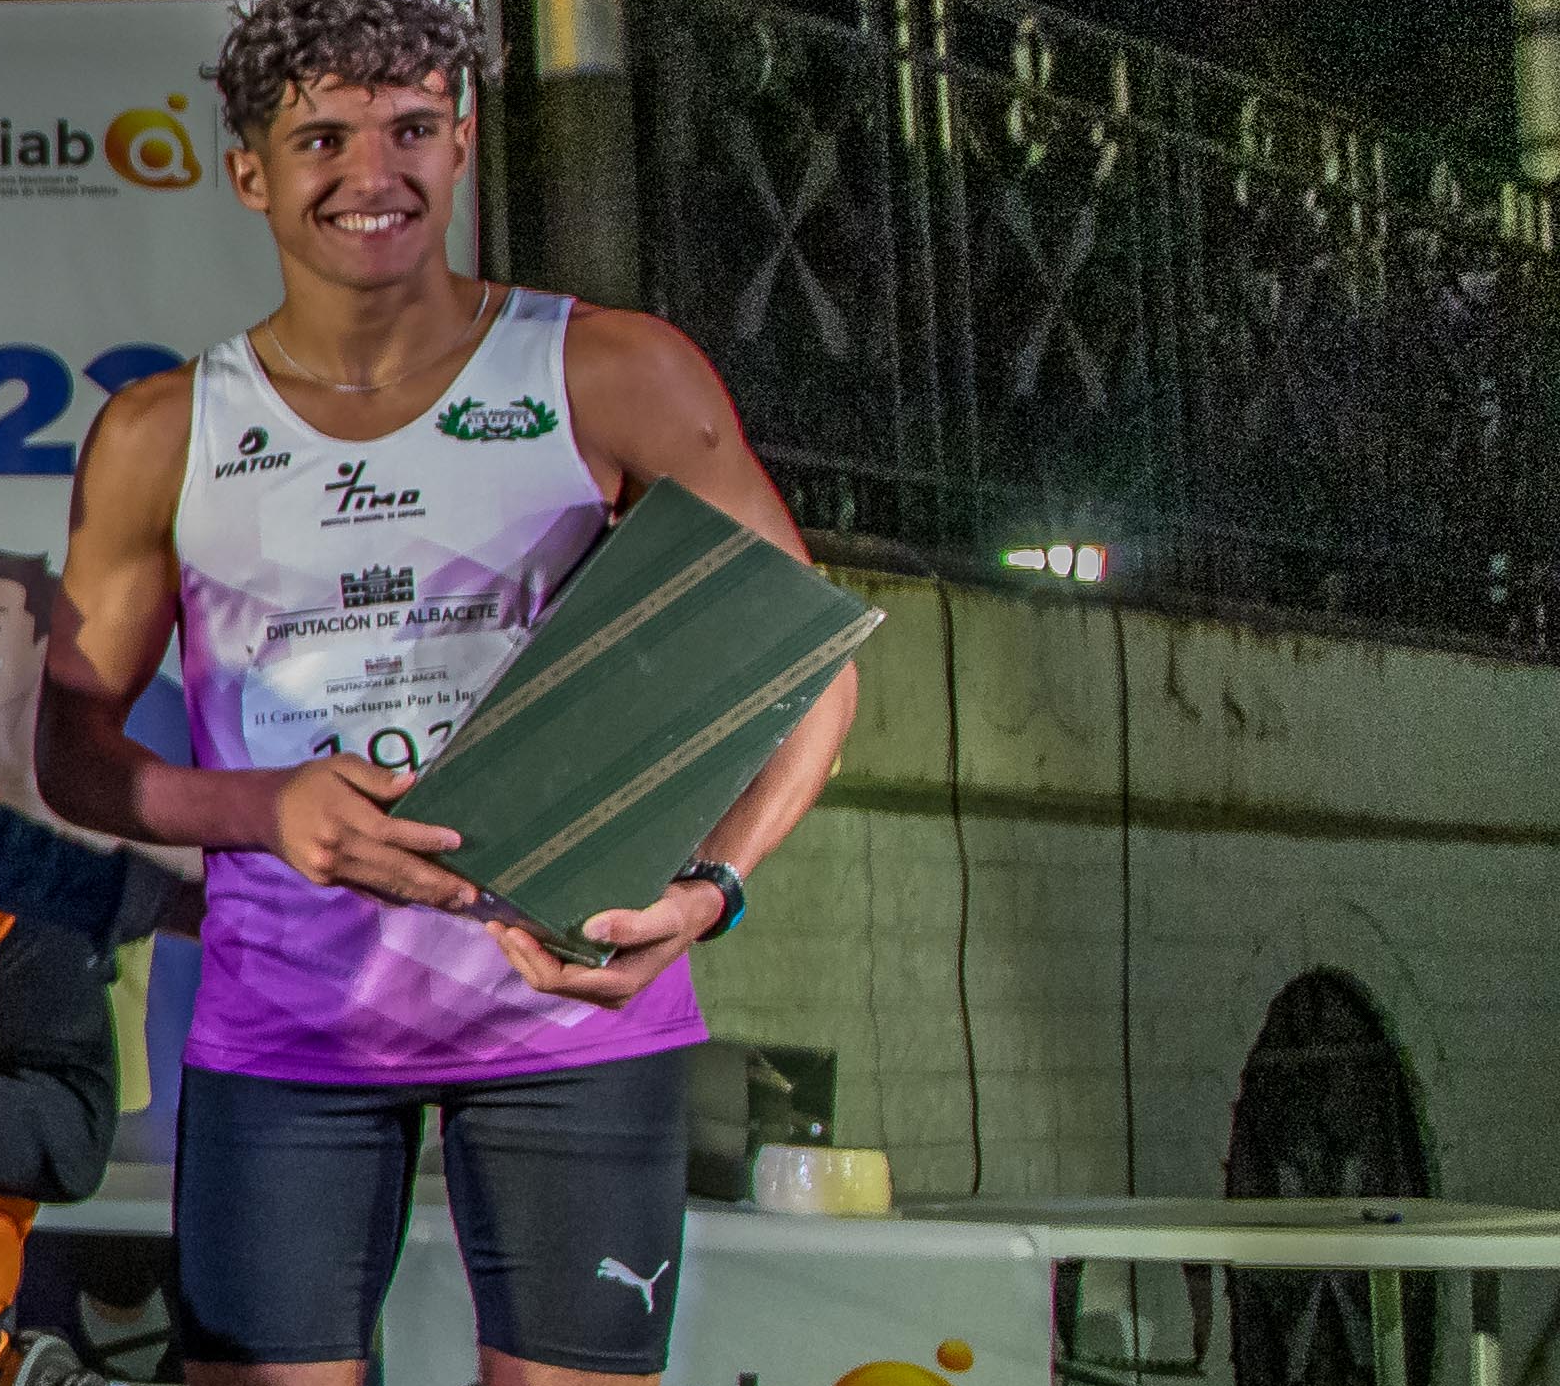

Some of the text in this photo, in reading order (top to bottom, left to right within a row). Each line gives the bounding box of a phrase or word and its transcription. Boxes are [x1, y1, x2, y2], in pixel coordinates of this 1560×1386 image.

[216, 452, 291, 479] VIATOR
[267, 602, 498, 641] DIPUTACIÓN DE ALBACETE
[270, 708, 328, 725] Carrera
[333, 699, 402, 714] Nocturna
[407, 694, 434, 707] Por
[437, 690, 451, 704] la
